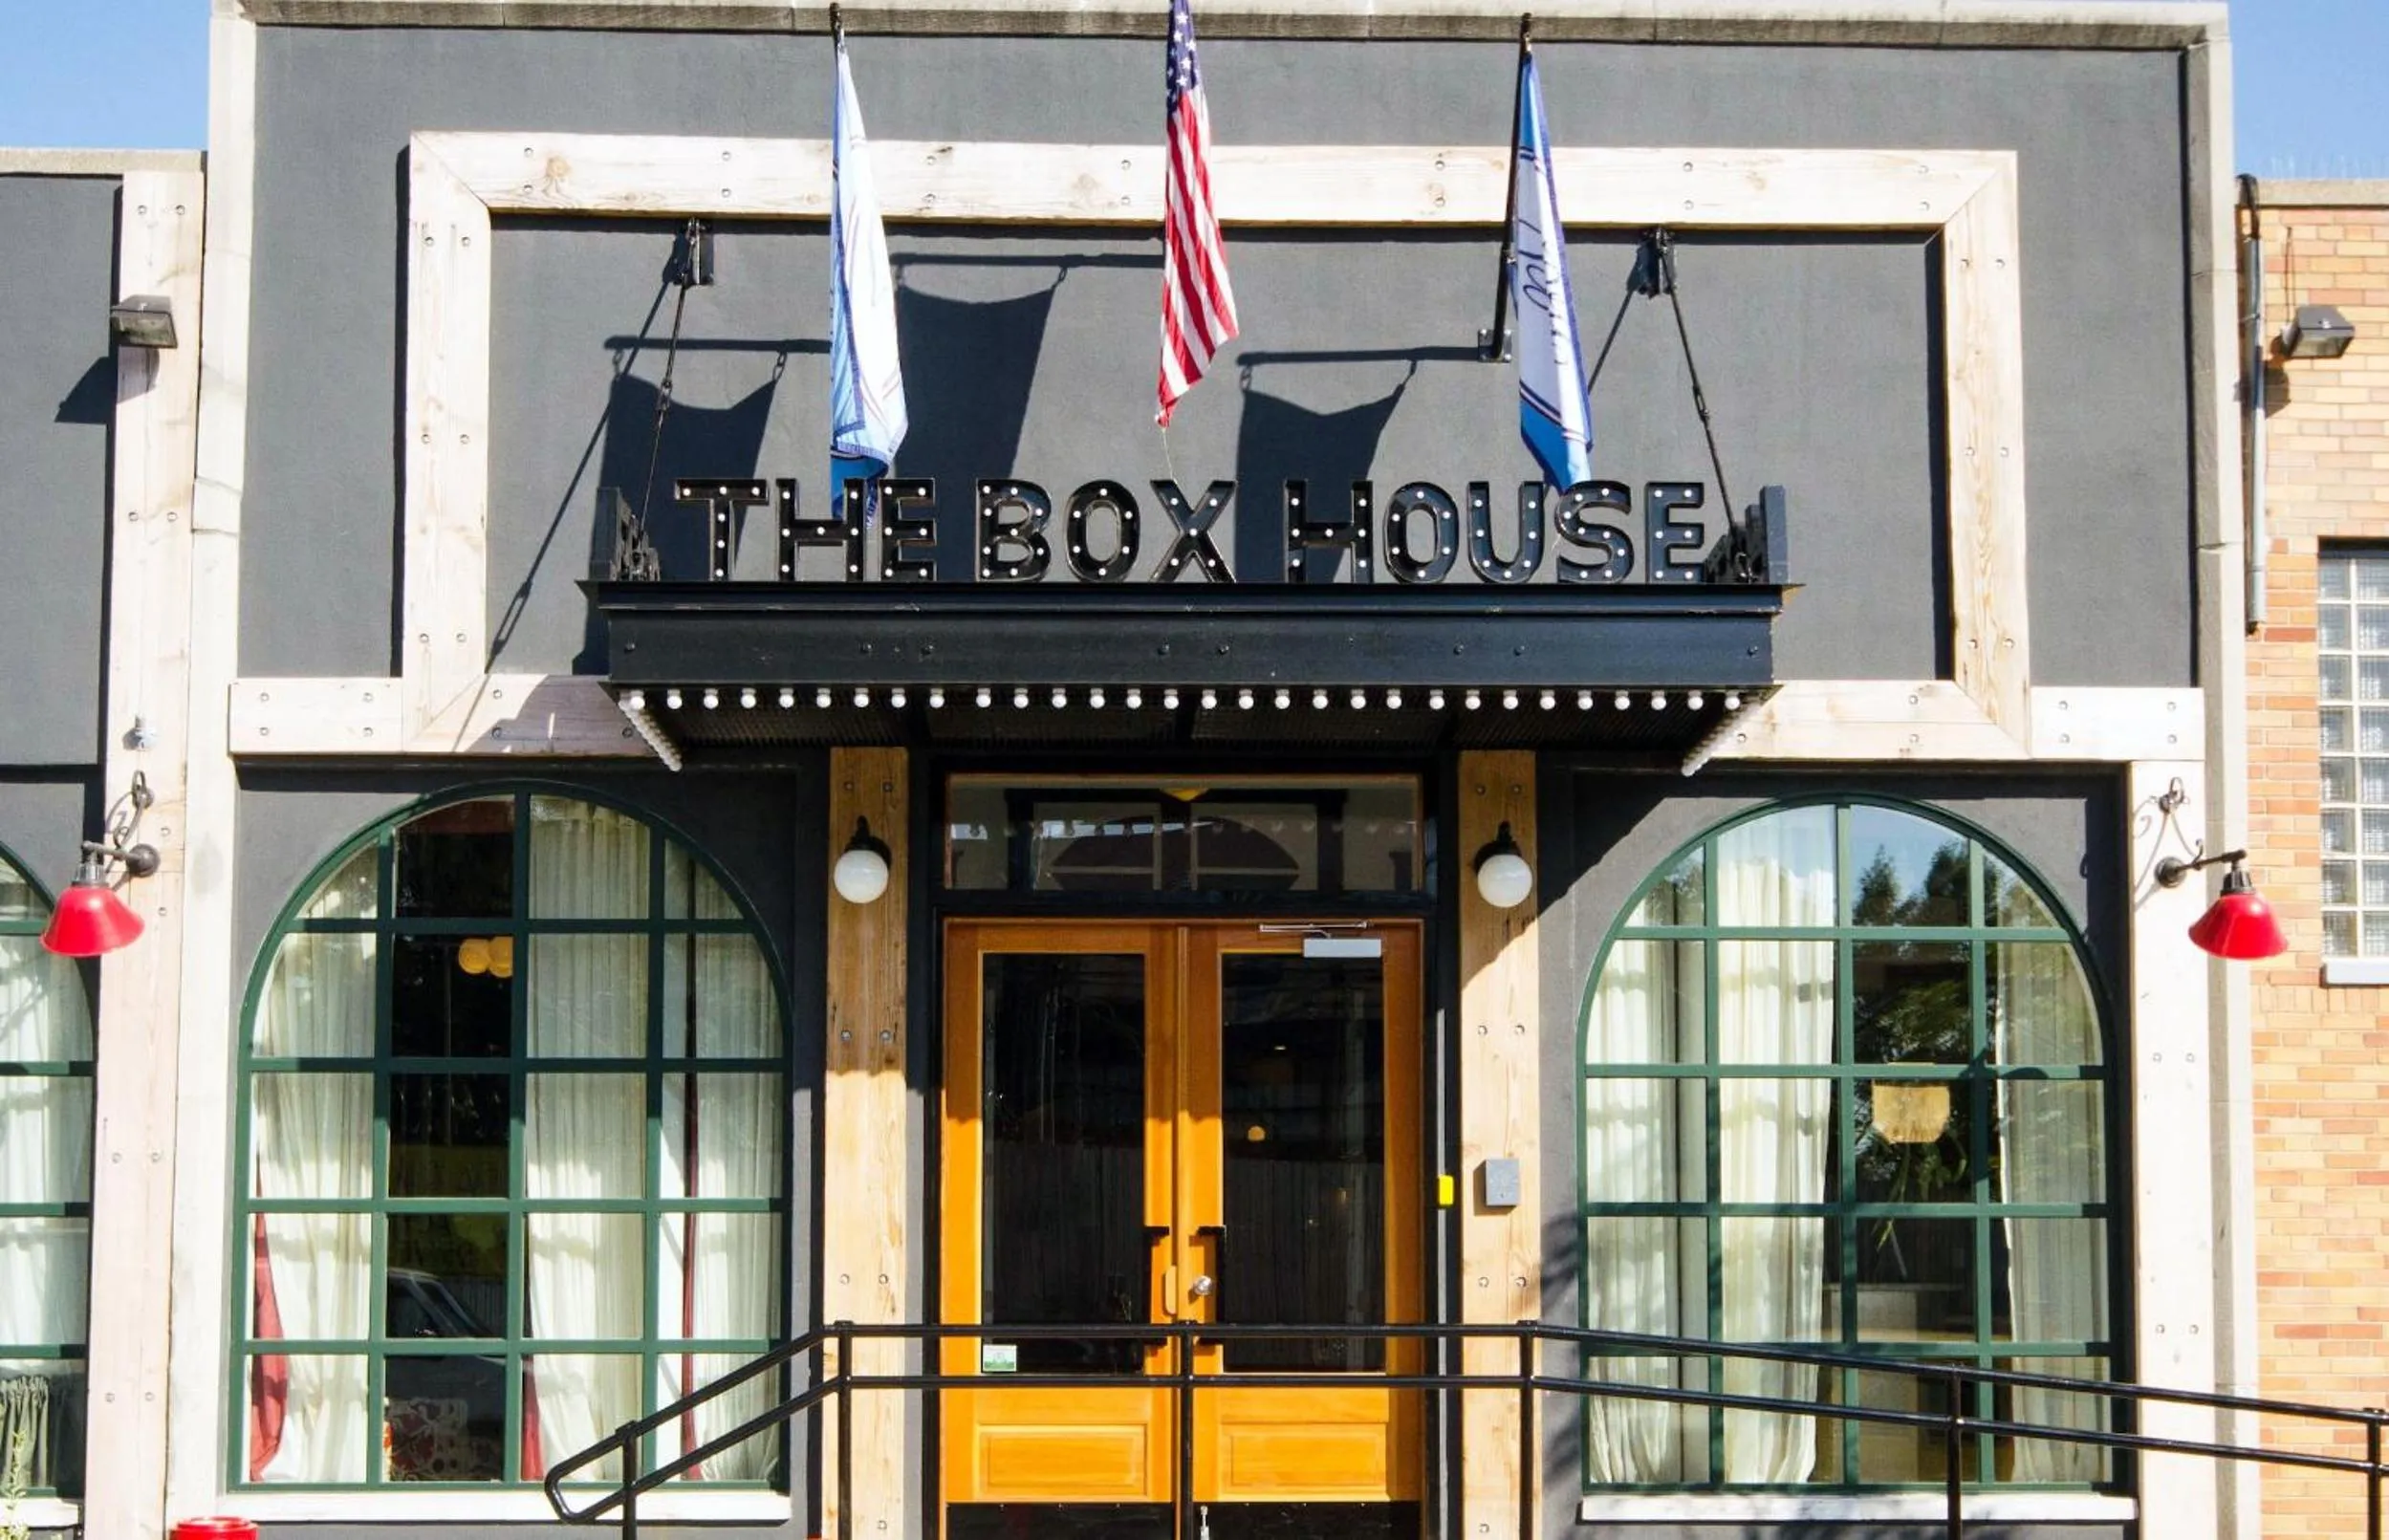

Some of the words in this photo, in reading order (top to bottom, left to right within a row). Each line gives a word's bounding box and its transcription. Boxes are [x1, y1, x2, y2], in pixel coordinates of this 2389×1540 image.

[674, 478, 937, 581] THE
[976, 478, 1237, 582] BOX
[1284, 480, 1705, 583] HOUSE
